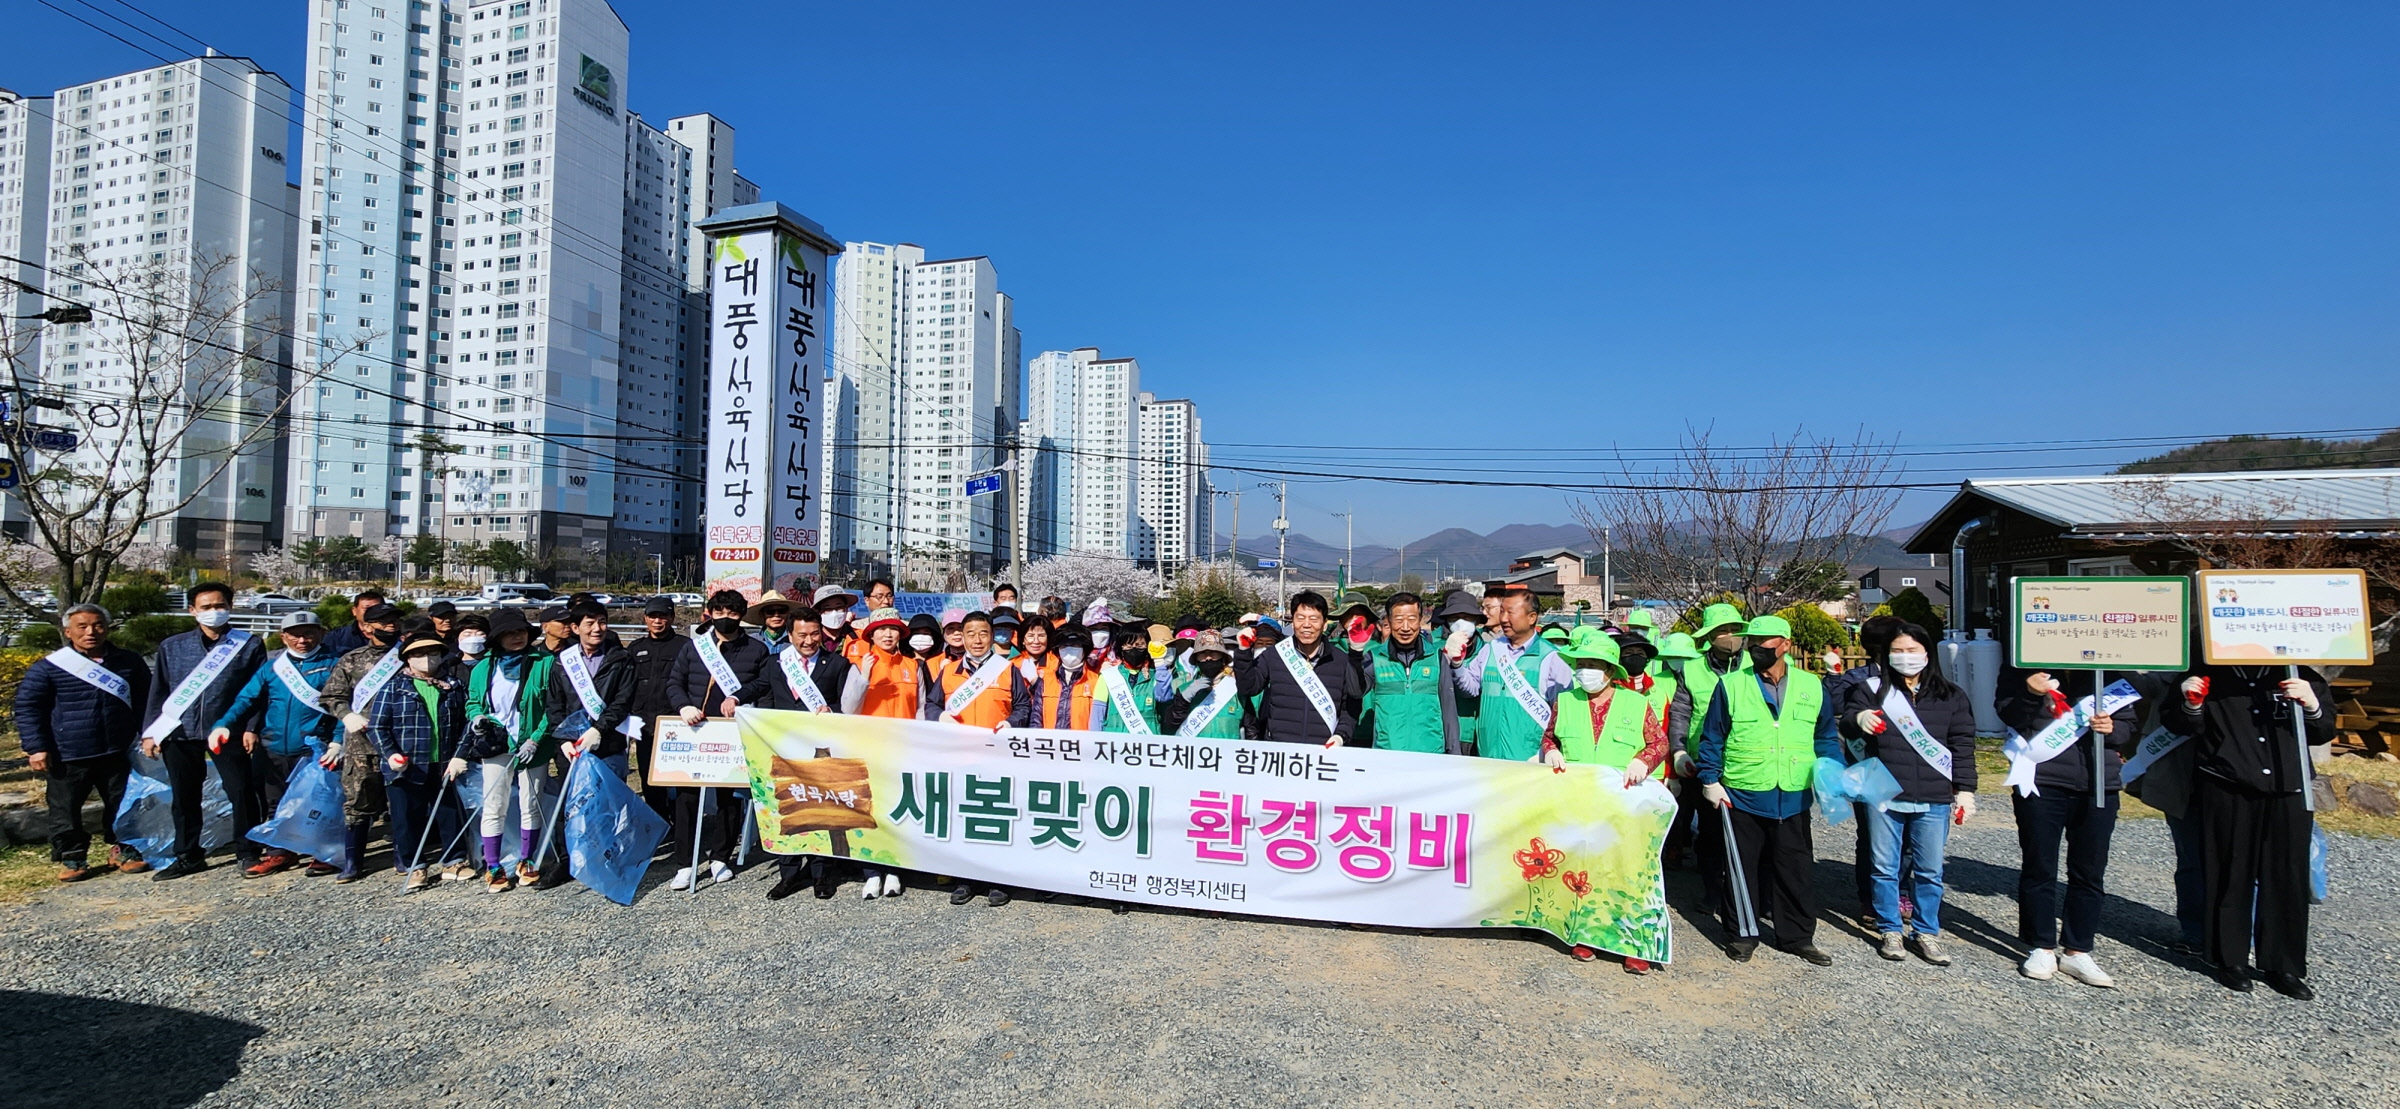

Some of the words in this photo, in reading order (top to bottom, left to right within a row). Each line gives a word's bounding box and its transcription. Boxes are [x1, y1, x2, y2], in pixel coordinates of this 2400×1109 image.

[573, 86, 615, 116] PRUGIO
[260, 146, 282, 161] 106
[724, 257, 759, 518] 대풍식육식당
[785, 265, 816, 521] 대풍식육식당
[245, 487, 266, 498] 106
[569, 475, 586, 487] 107
[710, 525, 762, 543] 식육유통
[773, 526, 818, 546] 식육유통
[714, 549, 756, 560] 772-2411
[777, 550, 813, 562] 772-2411
[2026, 613, 2057, 622] 깨끗한
[2059, 614, 2100, 623] 일류도시,
[2104, 613, 2136, 623] 친절한
[2138, 614, 2178, 623] 일류시민
[2213, 608, 2245, 616] 깨끗한
[2247, 607, 2288, 616] 일류도시,
[2291, 607, 2321, 617] 친절한
[2323, 607, 2359, 616] 일류시민
[205, 638, 239, 671] 아름다운
[1285, 648, 1308, 677] 아름다운
[87, 667, 129, 695] 아름다운
[566, 655, 589, 689] 아름다운
[788, 662, 807, 687] 깨끗한
[1502, 666, 1522, 691] 깨끗한
[951, 687, 975, 709] 깨끗한
[1909, 728, 1941, 758] 깨끗한
[1008, 736, 1082, 762] 현곡면
[1094, 741, 1224, 772] 자생단체와
[1235, 749, 1340, 782] 함께하는
[788, 783, 858, 810] 현곡사랑
[891, 771, 1151, 857] 새봄맞이
[1187, 791, 1471, 885] 환경정비
[1089, 870, 1137, 893] 현곡면
[1146, 874, 1246, 902] 행정복지센터
